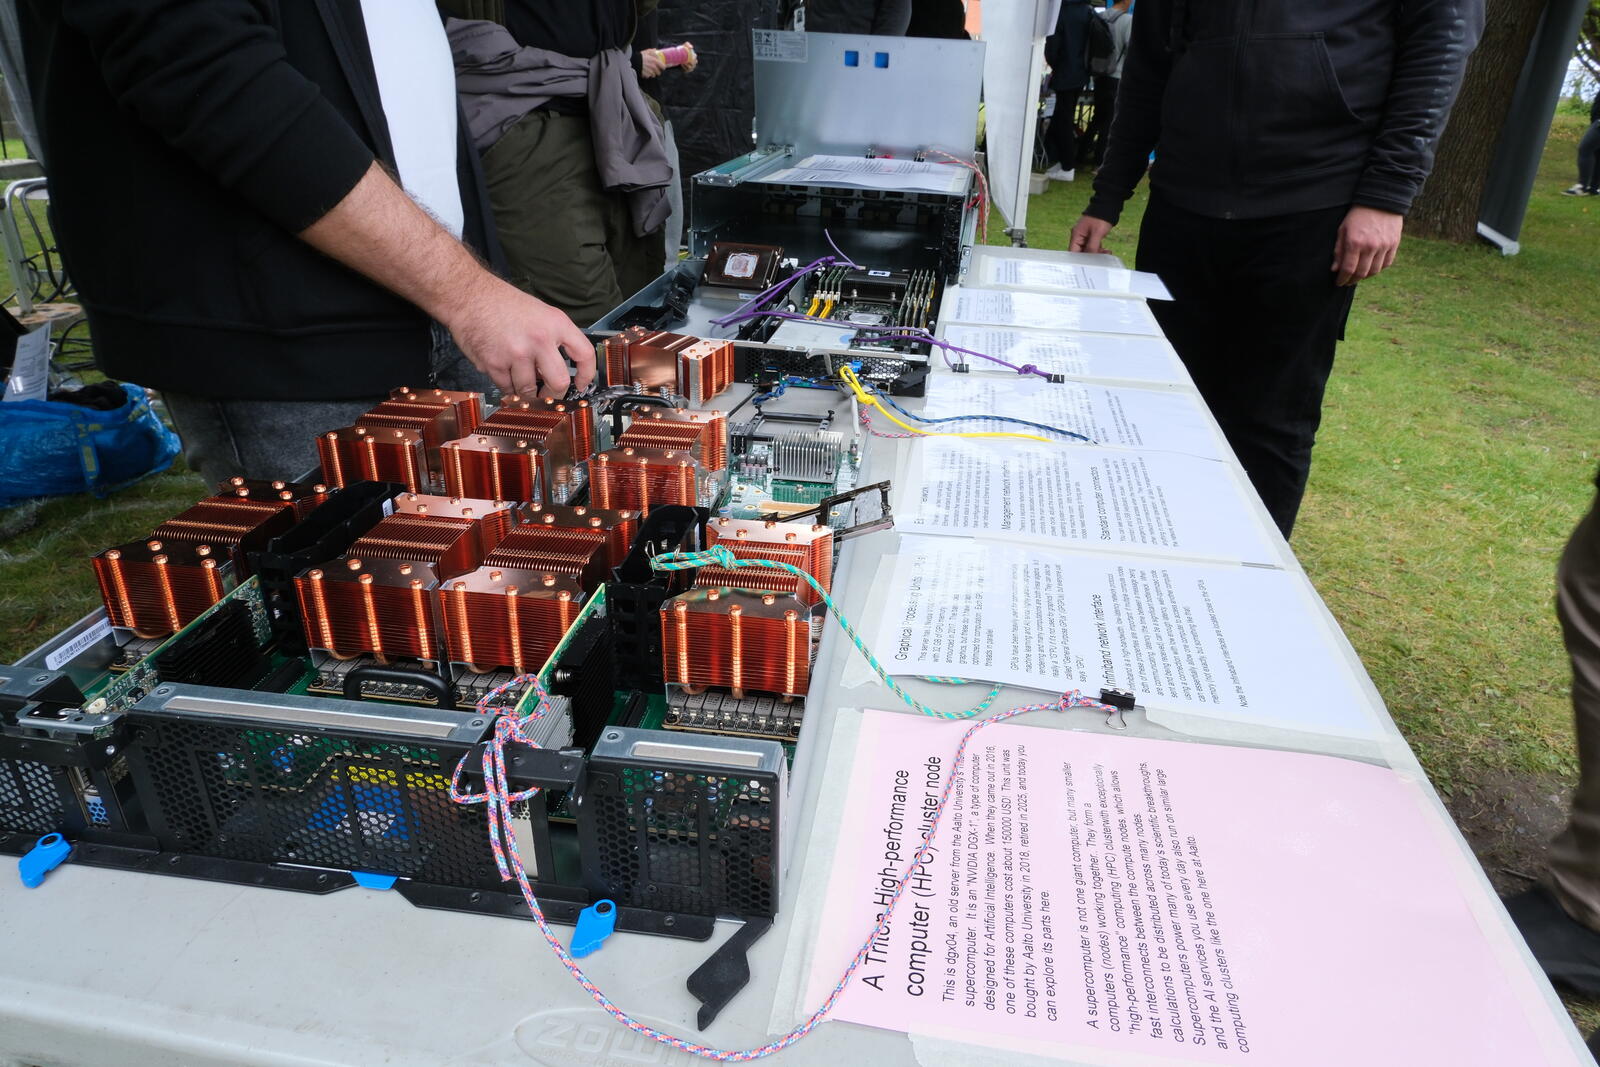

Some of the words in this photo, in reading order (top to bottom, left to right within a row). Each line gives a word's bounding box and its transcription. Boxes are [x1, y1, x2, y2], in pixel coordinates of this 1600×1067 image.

[1090, 466, 1102, 492] connectors
[1094, 491, 1107, 515] computer
[1097, 515, 1111, 541] Standard
[1091, 593, 1104, 621] interface
[1094, 622, 1110, 649] network
[1099, 650, 1116, 687] Infiniband
[985, 746, 996, 763] 2016,
[1002, 749, 1010, 762] was
[1017, 744, 1028, 756] you
[924, 756, 941, 788] node
[971, 753, 981, 784] computer
[986, 770, 996, 783] out
[1002, 763, 1011, 776] unit
[1016, 758, 1028, 776] today
[1062, 762, 1073, 786] smaller
[1156, 769, 1167, 786] large
[953, 770, 966, 811] University's
[969, 784, 980, 793] of
[1001, 777, 1011, 791] This
[1017, 777, 1027, 790] and
[1094, 764, 1108, 808] exceptionally
[1110, 770, 1121, 792] allows
[1139, 762, 1156, 813] breakthroughs,
[970, 794, 982, 810] type
[987, 783, 996, 803] came
[1017, 793, 1028, 812] 2025,
[1066, 788, 1076, 808] many
[1113, 794, 1124, 815] which
[1160, 787, 1172, 812] similar
[918, 792, 938, 840] cluster
[985, 804, 998, 820] they
[1001, 795, 1012, 815] USD!
[1067, 809, 1077, 821] but
[952, 812, 963, 832] Aalto
[1020, 813, 1028, 821] in
[1084, 809, 1094, 826] form
[1133, 812, 1144, 837] nodes.
[1165, 813, 1175, 824] on
[952, 834, 962, 847] the
[985, 822, 995, 845] When
[1001, 816, 1012, 845] 150000
[1018, 822, 1029, 847] retired
[1086, 828, 1098, 847] They
[1117, 817, 1129, 842] nodes,
[1148, 814, 1164, 848] scientific
[1168, 824, 1178, 838] run
[1070, 824, 1082, 862] computer,
[1138, 838, 1149, 862] many
[1171, 839, 1183, 857] also
[1186, 835, 1200, 858] Aalto.
[949, 849, 961, 867] from
[966, 852, 978, 886] "NVIDIA
[1002, 847, 1013, 871] about
[1019, 850, 1030, 873] 2018,
[1104, 852, 1120, 879] (HPC)
[1122, 844, 1136, 880] compute
[1155, 850, 1170, 880] today's
[1176, 858, 1188, 875] day
[1191, 858, 1202, 868] at
[862, 975, 885, 991] A
[874, 770, 908, 906] High-performance
[911, 846, 939, 897] (HPC)
[950, 869, 960, 897] server
[984, 851, 998, 900] Intelligence.
[1003, 873, 1014, 892] cost
[1020, 874, 1030, 883] in
[1072, 864, 1086, 886] giant
[1142, 864, 1156, 892] across
[1195, 869, 1208, 889] here
[968, 889, 977, 901] an
[1076, 887, 1086, 905] one
[1128, 882, 1139, 897] the
[1160, 880, 1173, 891] of
[1179, 876, 1193, 901] every
[948, 898, 959, 913] old
[966, 903, 977, 911] is
[1021, 885, 1033, 930] University
[1040, 890, 1050, 912] here.
[1094, 892, 1106, 928] working
[1110, 881, 1125, 929] computing
[1166, 892, 1178, 918] many
[1201, 891, 1213, 909] one
[948, 915, 958, 928] an
[984, 902, 996, 941] Artificial
[1003, 894, 1016, 944] computers
[1076, 906, 1088, 922] not
[1131, 899, 1146, 940] between
[1146, 894, 1165, 944] distributed
[1186, 903, 1198, 921] use
[1205, 911, 1217, 926] the
[1040, 915, 1054, 940] parts
[1078, 924, 1089, 933] is
[1171, 920, 1188, 952] power
[1190, 922, 1205, 941] you
[1210, 928, 1222, 946] like
[907, 903, 932, 996] computer
[945, 932, 960, 965] dgx04,
[983, 942, 996, 957] for
[1022, 933, 1034, 960] Aalto
[1042, 942, 1053, 954] its
[1097, 931, 1115, 970] (nodes)
[1157, 946, 1169, 960] be
[944, 967, 956, 977] is
[965, 927, 978, 1006] supercomputer.
[1003, 946, 1015, 975] these
[1023, 962, 1038, 976] by
[1160, 962, 1171, 972] to
[1195, 944, 1213, 987] services
[1215, 948, 1233, 989] clusters
[983, 959, 998, 1010] designed
[1002, 976, 1016, 989] of
[1043, 956, 1057, 997] explore
[1080, 935, 1099, 1016] supercomputer
[1116, 931, 1142, 1034] "high-performance"
[1137, 942, 1158, 1014] interconnects
[942, 979, 956, 1002] This
[1024, 978, 1038, 1018] bought
[1178, 954, 1206, 1045] Supercomputers
[1202, 989, 1217, 1003] AI
[1006, 992, 1016, 1014] one
[1046, 1000, 1058, 1022] can
[1104, 973, 1120, 1032] computers
[1163, 976, 1184, 1042] calculations
[1209, 1005, 1222, 1023] the
[1086, 1020, 1100, 1030] A
[1149, 1016, 1163, 1039] fast
[1226, 992, 1250, 1053] computing
[1211, 1026, 1228, 1050] and
